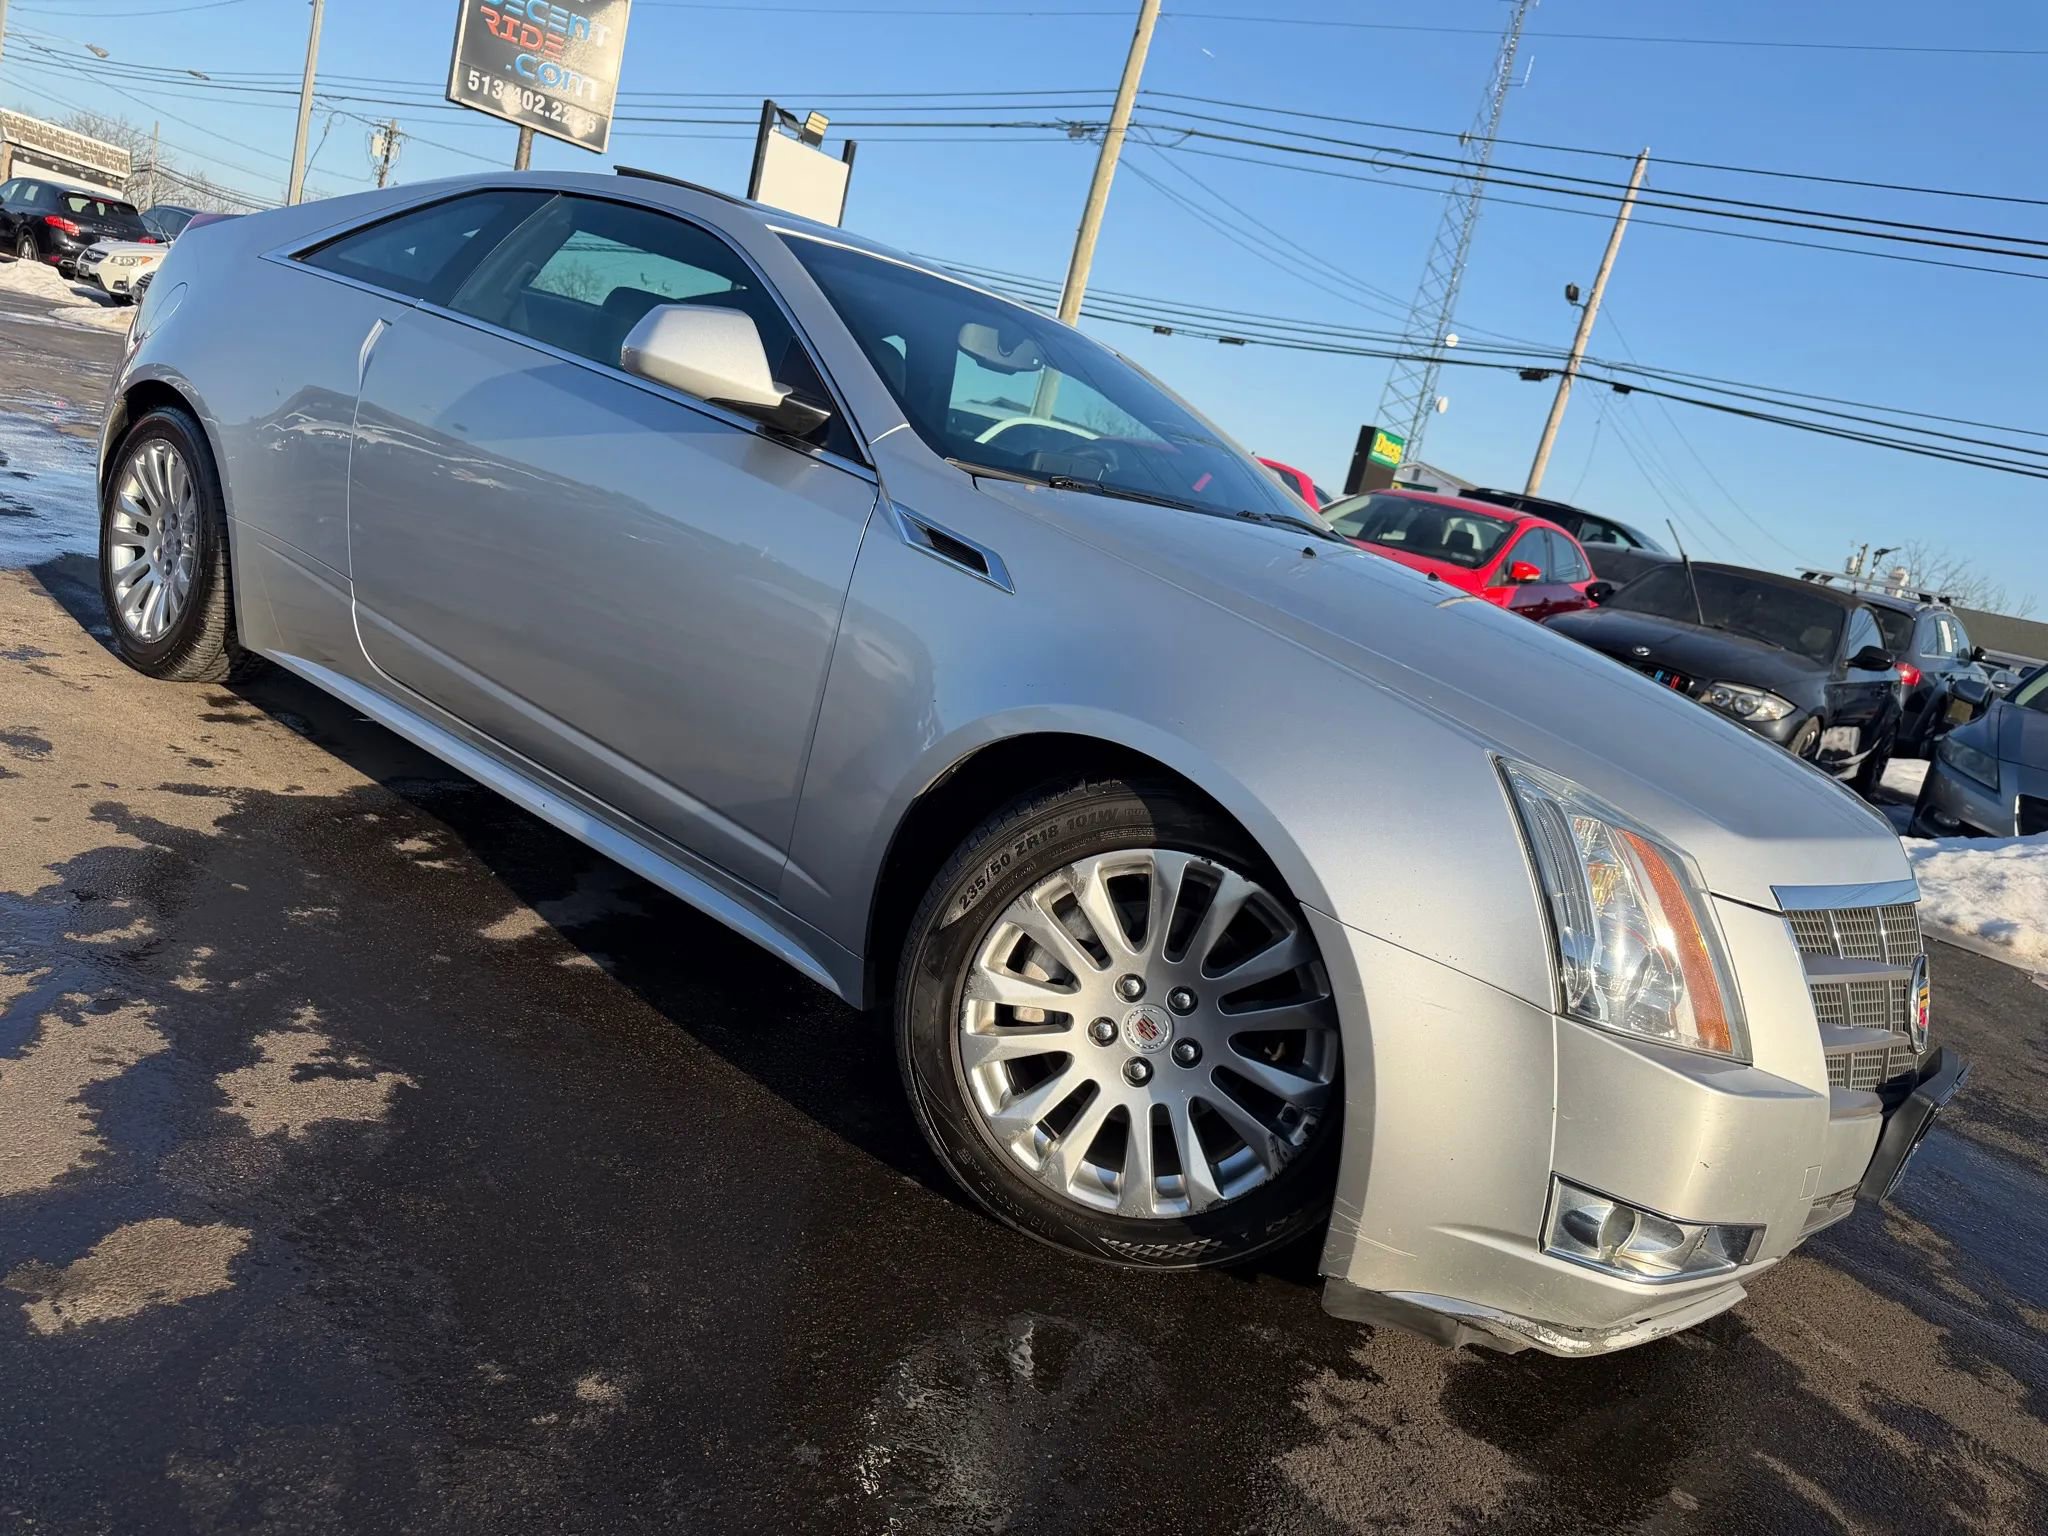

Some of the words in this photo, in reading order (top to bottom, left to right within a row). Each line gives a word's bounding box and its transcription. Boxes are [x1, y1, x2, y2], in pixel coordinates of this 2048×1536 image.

[480, 5, 565, 62] RIDE
[485, 0, 612, 48] ECENT
[958, 853, 1011, 911] 235/50
[1014, 824, 1059, 857] ZR18
